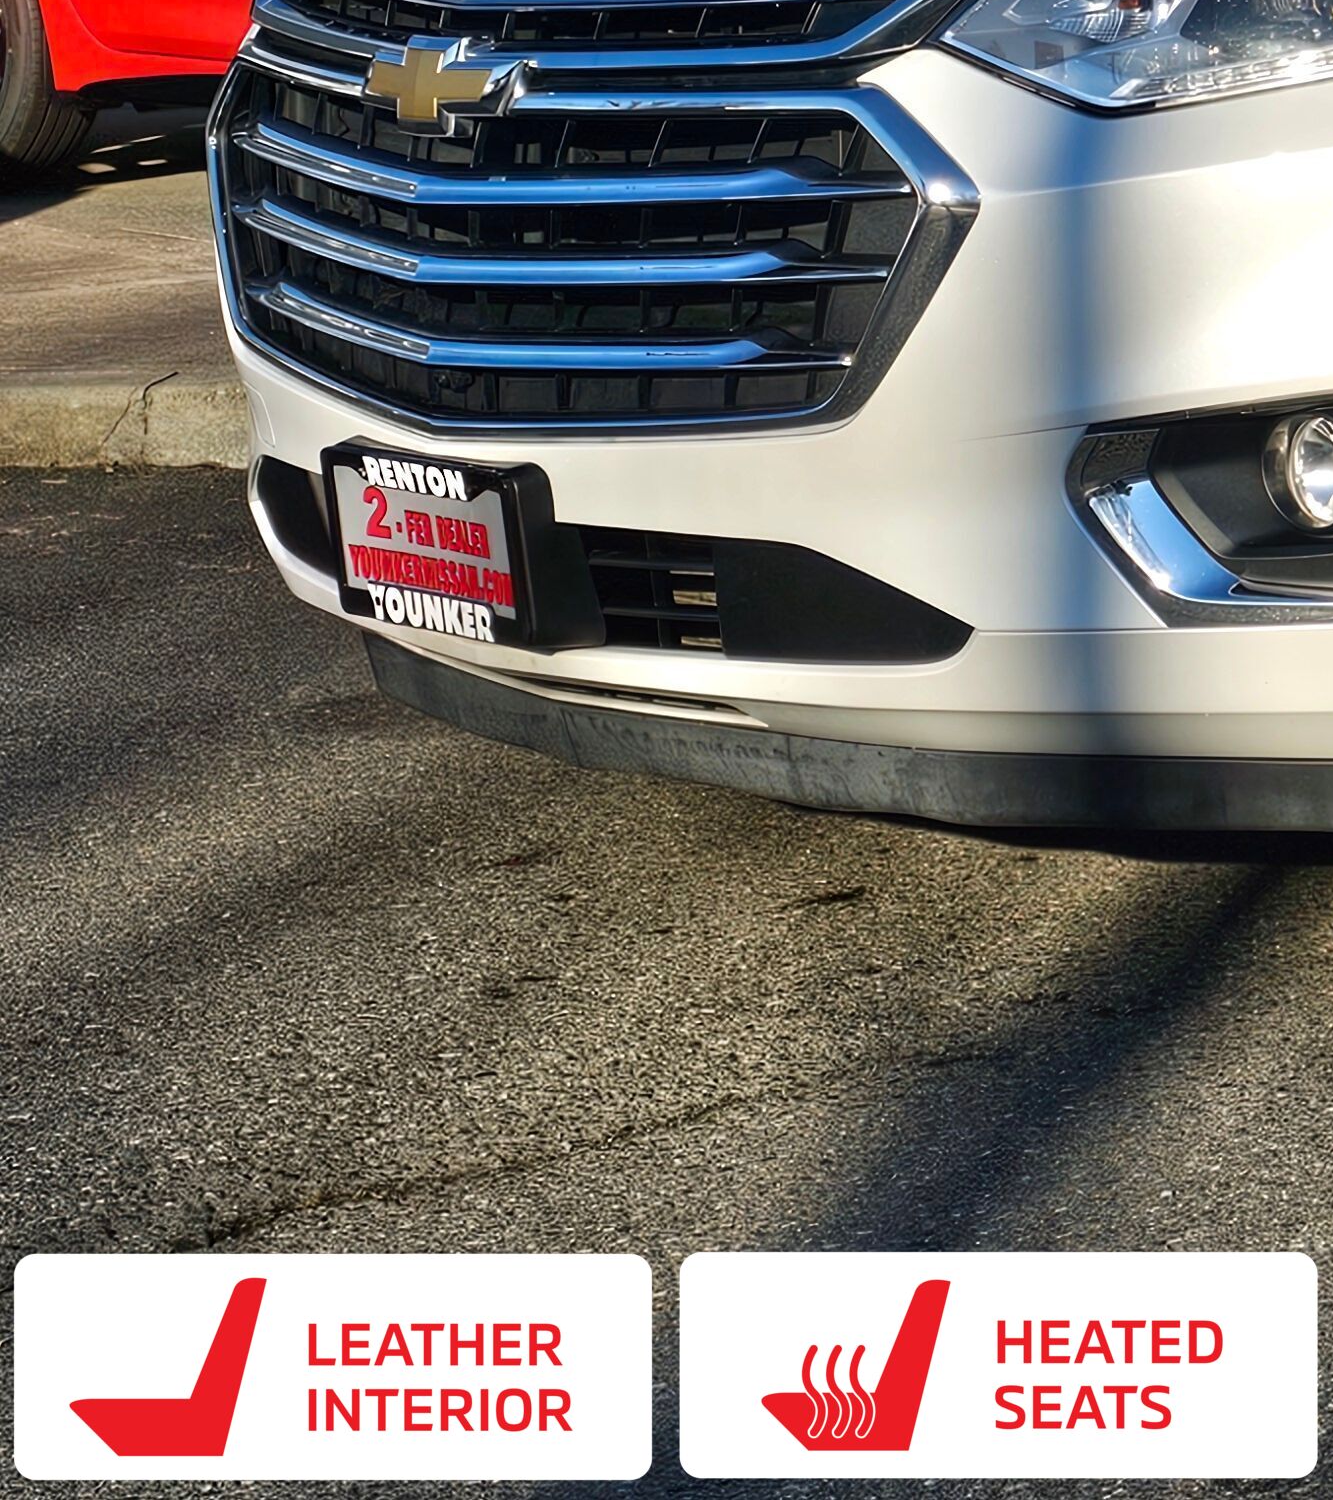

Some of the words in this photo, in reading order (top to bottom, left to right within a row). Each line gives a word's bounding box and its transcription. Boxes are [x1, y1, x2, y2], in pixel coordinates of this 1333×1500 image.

[361, 456, 467, 501] RENTON
[435, 515, 491, 560] DEALER
[367, 582, 496, 643] YOUNKER
